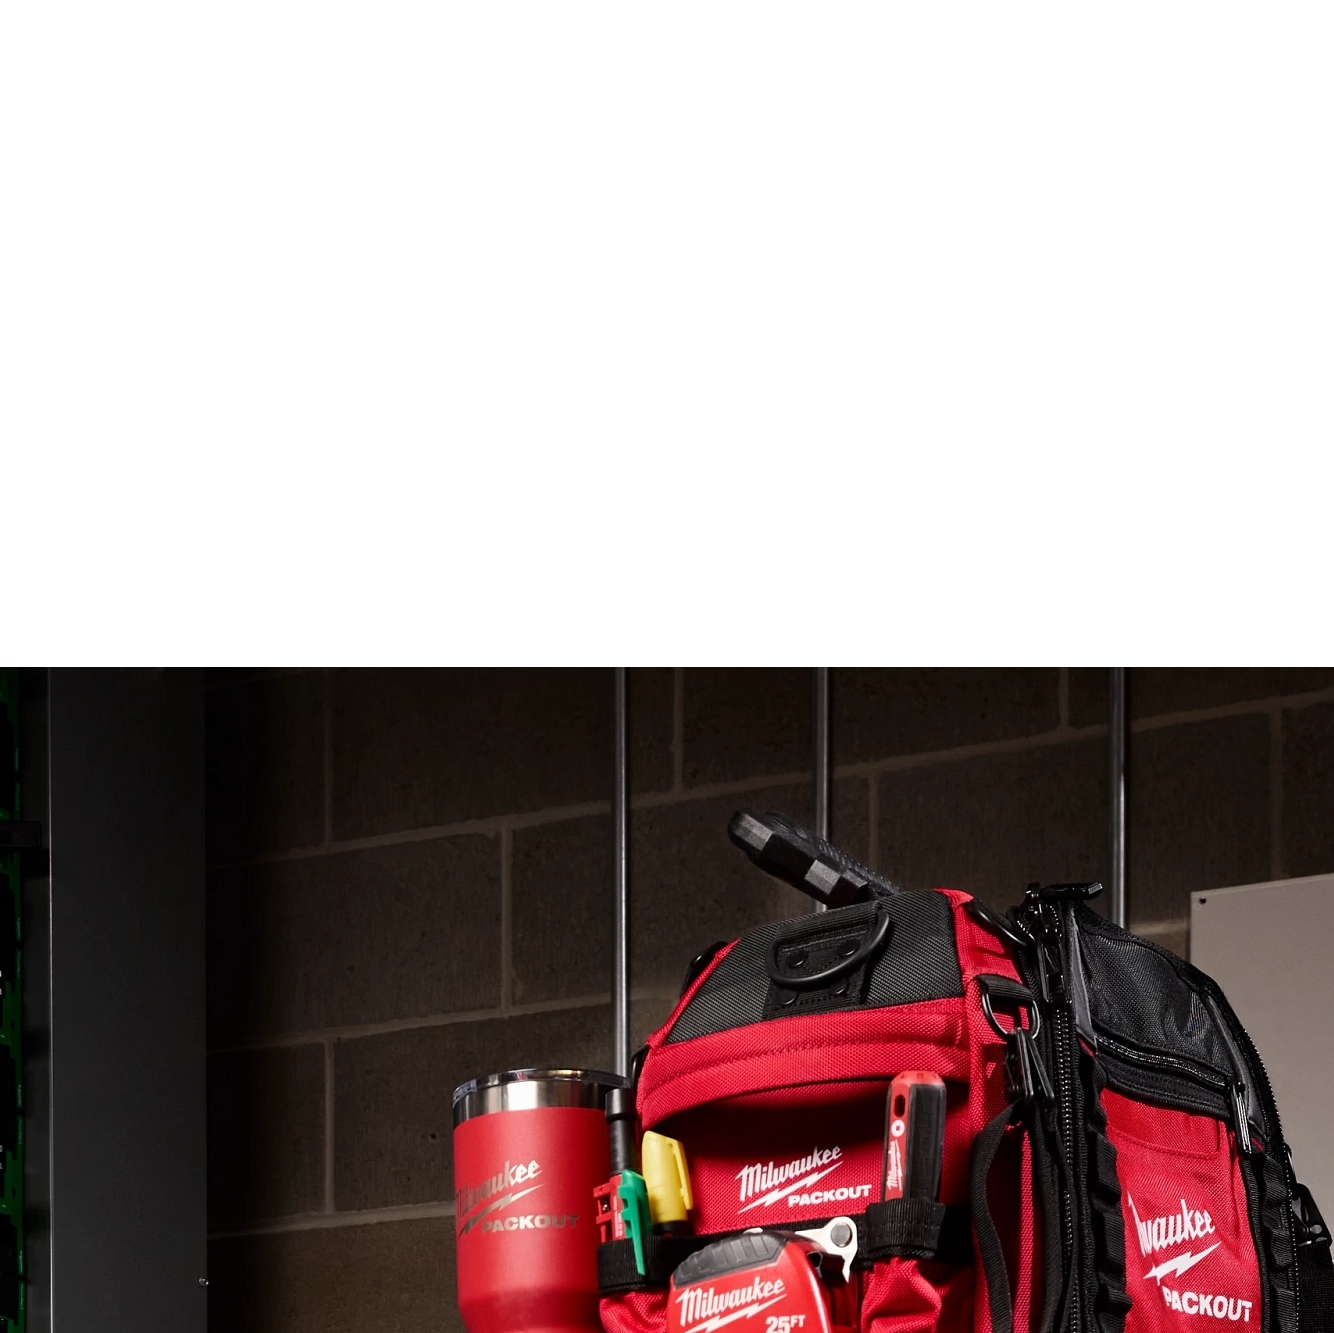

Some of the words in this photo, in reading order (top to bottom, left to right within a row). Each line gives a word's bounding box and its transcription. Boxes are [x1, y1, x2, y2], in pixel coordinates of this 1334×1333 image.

[734, 1145, 843, 1202] Milwaukee
[885, 1141, 897, 1191] Milwaukee
[788, 1184, 872, 1208] PACKOUT
[481, 1214, 579, 1233] PACKOUT
[675, 1276, 786, 1327] Milwaukee
[1161, 1285, 1253, 1322] PACKOUT
